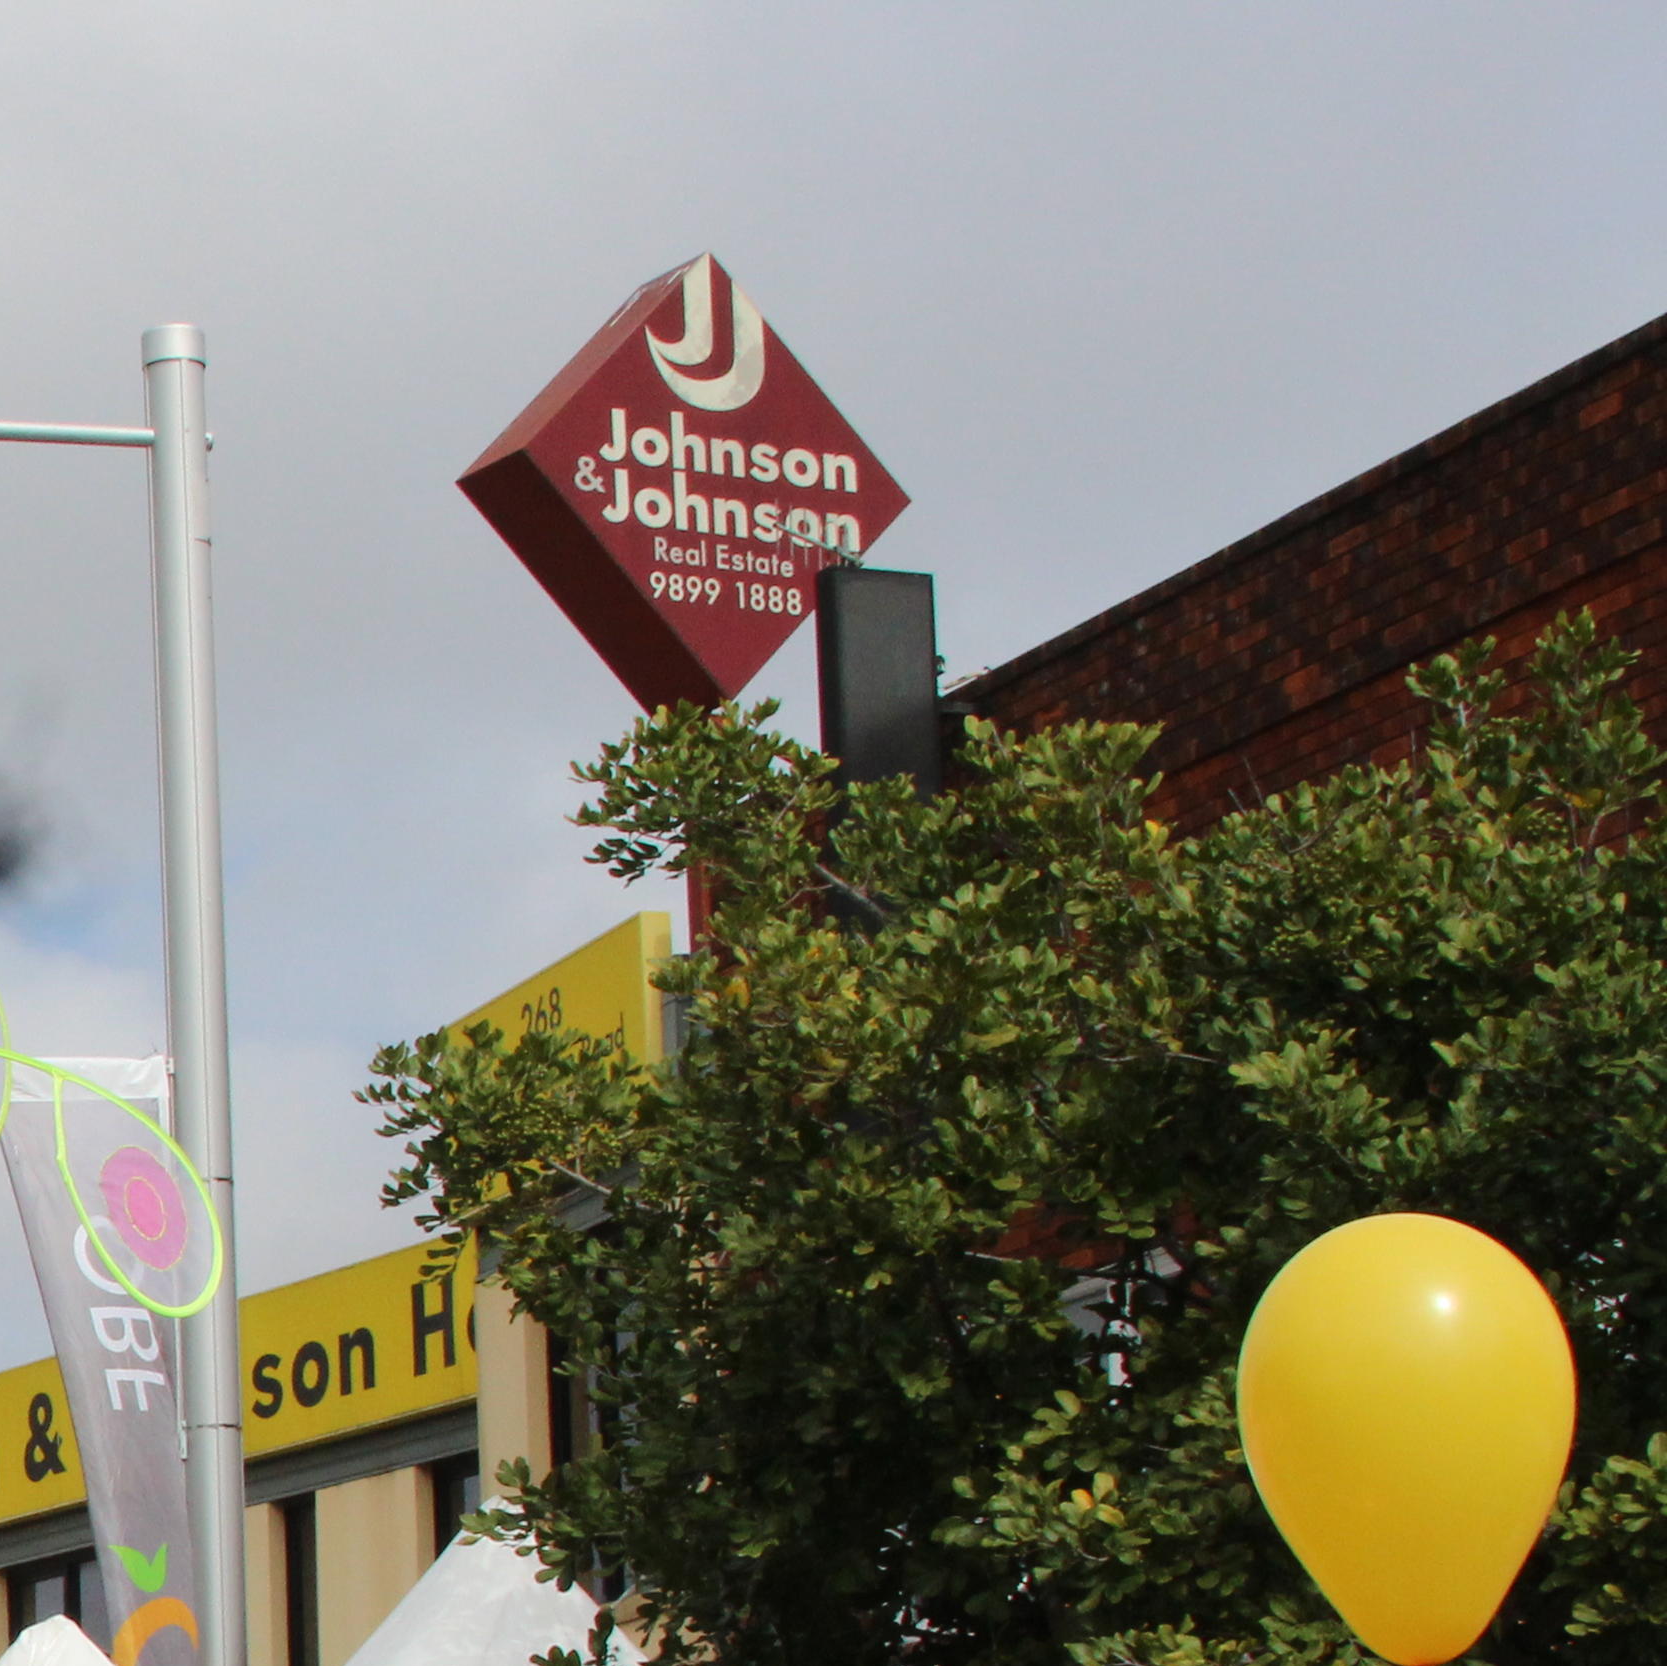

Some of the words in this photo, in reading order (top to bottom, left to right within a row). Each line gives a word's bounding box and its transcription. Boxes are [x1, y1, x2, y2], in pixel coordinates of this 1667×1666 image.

[599, 407, 858, 493] Johnson
[574, 455, 606, 493] &
[602, 468, 860, 552] Johnson
[653, 537, 708, 567] Real
[716, 544, 795, 578] Estate
[649, 571, 721, 604] 9899
[735, 581, 802, 616] 1888
[521, 986, 561, 1034] 268
[24, 1392, 67, 1483] &
